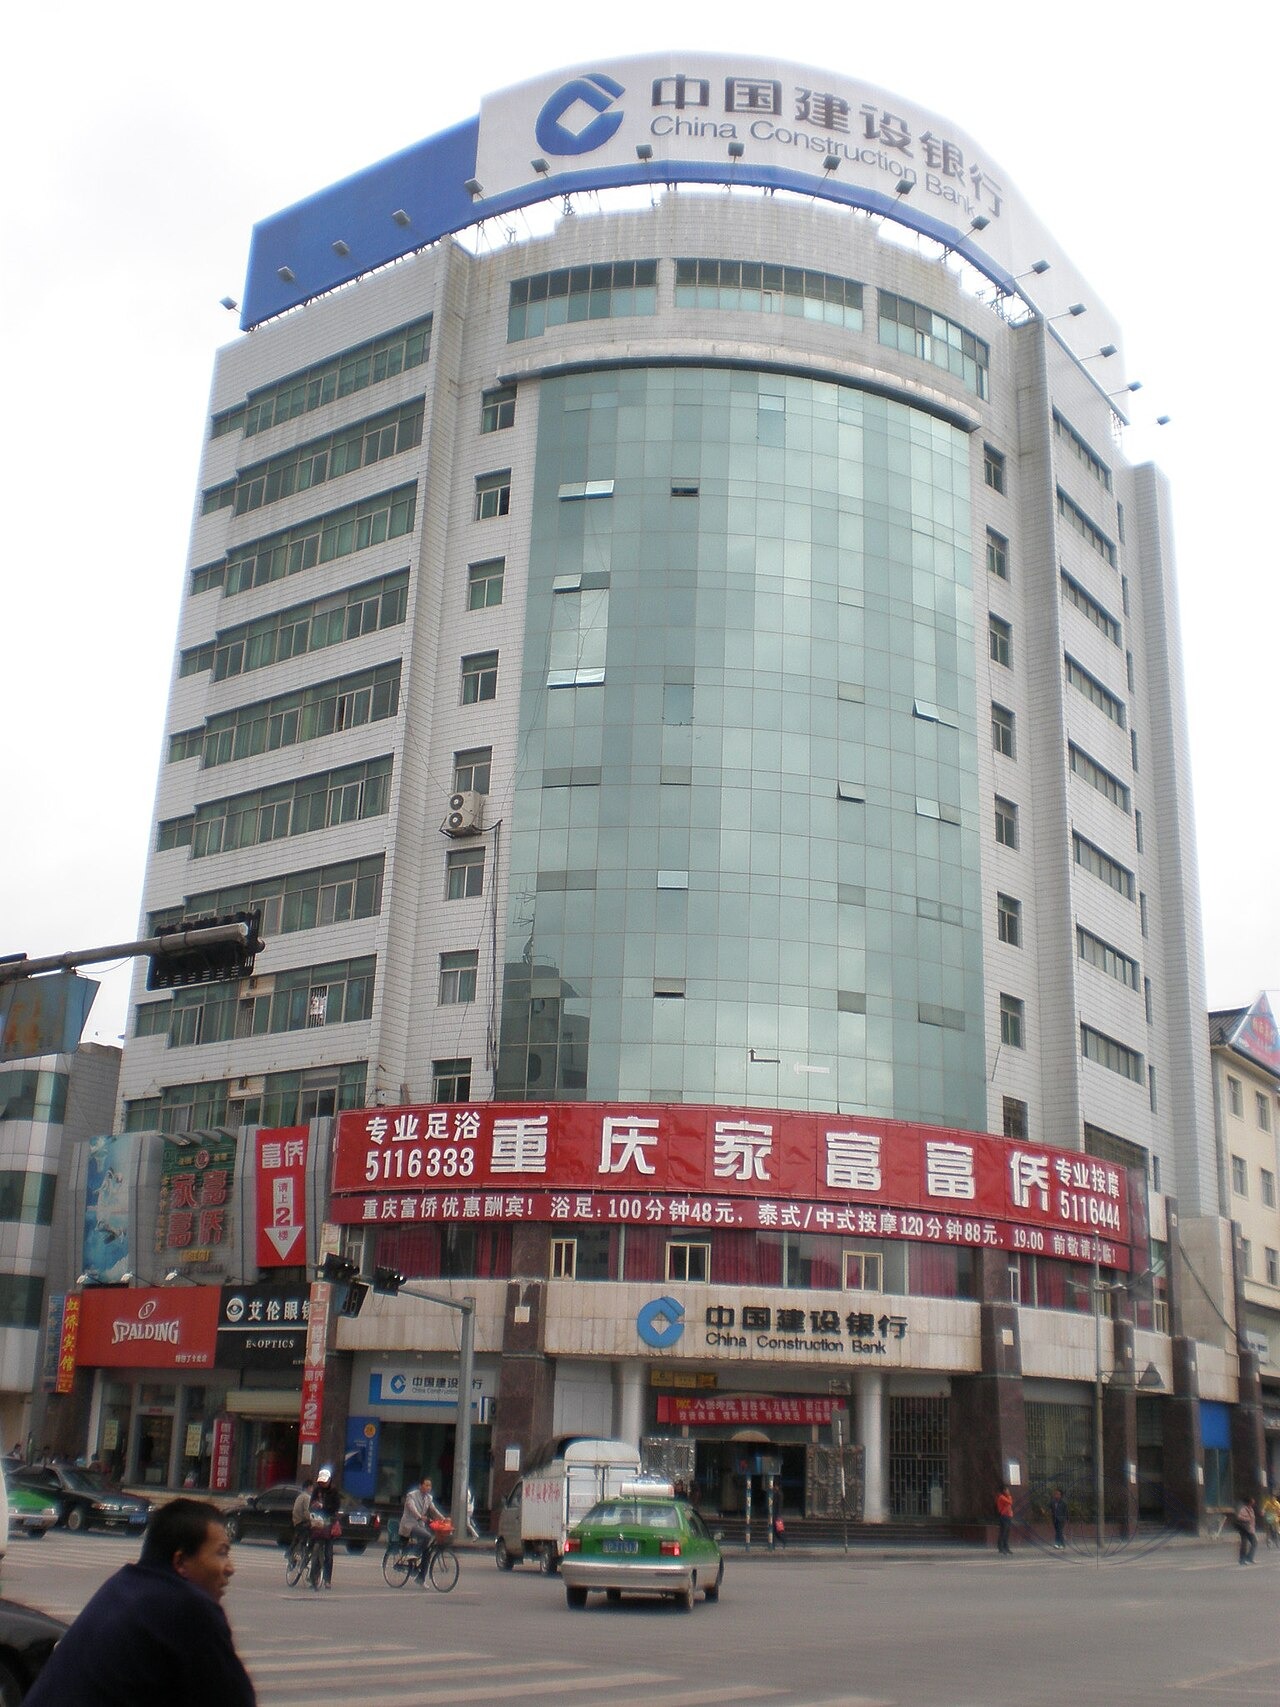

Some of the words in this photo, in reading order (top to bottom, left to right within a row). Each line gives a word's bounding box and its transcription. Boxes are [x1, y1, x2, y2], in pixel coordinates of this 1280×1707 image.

[651, 72, 1003, 218] 中国建设银行
[650, 115, 737, 139] China
[750, 120, 917, 186] Construction
[925, 171, 976, 216] Bank
[365, 1111, 481, 1146] 专业足浴
[261, 1140, 304, 1169] 富侨
[365, 1147, 475, 1182] 5116333
[489, 1114, 1049, 1212] 重庆家富富侨
[1055, 1158, 1121, 1199] 专业按摩
[1059, 1191, 1121, 1232] 5116444
[1013, 1229, 1044, 1250] 19:00
[111, 1320, 179, 1344] SPALDING
[705, 1305, 908, 1340] 中国建设银行
[705, 1332, 747, 1348] China
[757, 1335, 844, 1352] Construction
[852, 1340, 887, 1354] Bank
[412, 1377, 482, 1390] 中国建设行
